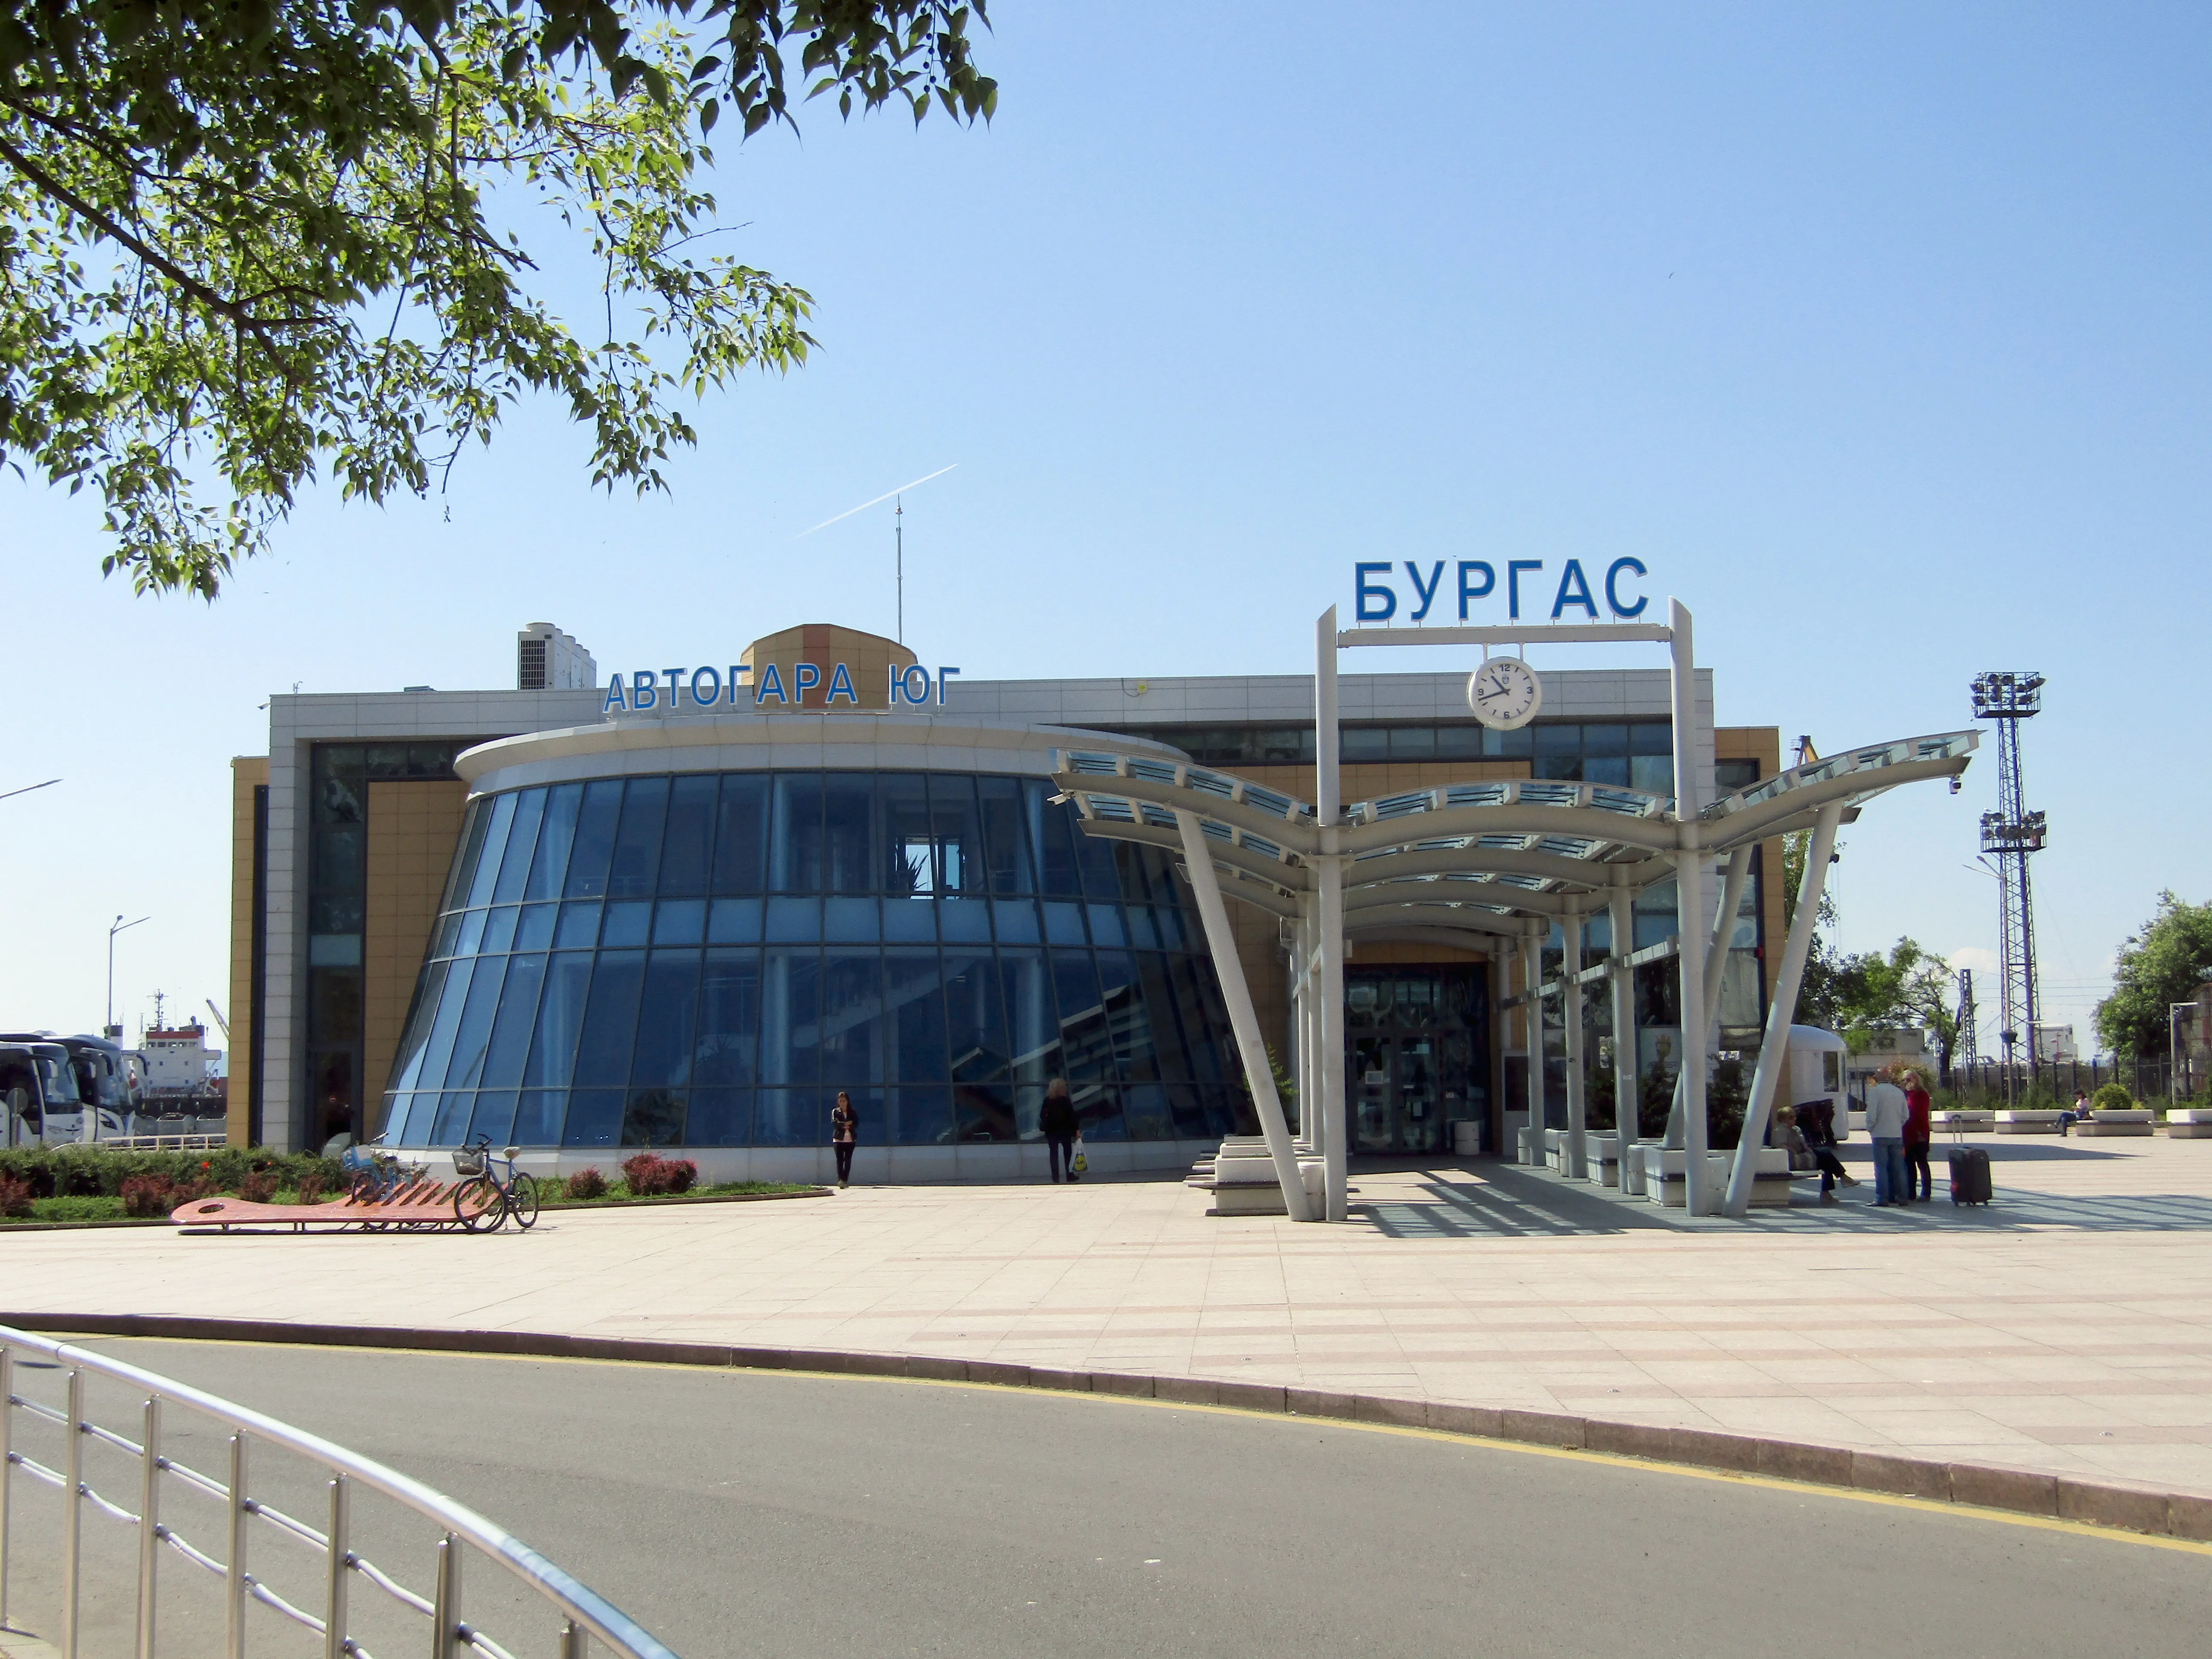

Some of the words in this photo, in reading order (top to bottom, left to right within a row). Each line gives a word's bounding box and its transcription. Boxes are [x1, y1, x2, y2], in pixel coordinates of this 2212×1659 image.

[1355, 556, 1650, 622] БУРГАС
[602, 663, 859, 714] АВТОГАРА
[889, 663, 961, 706] ЮГ
